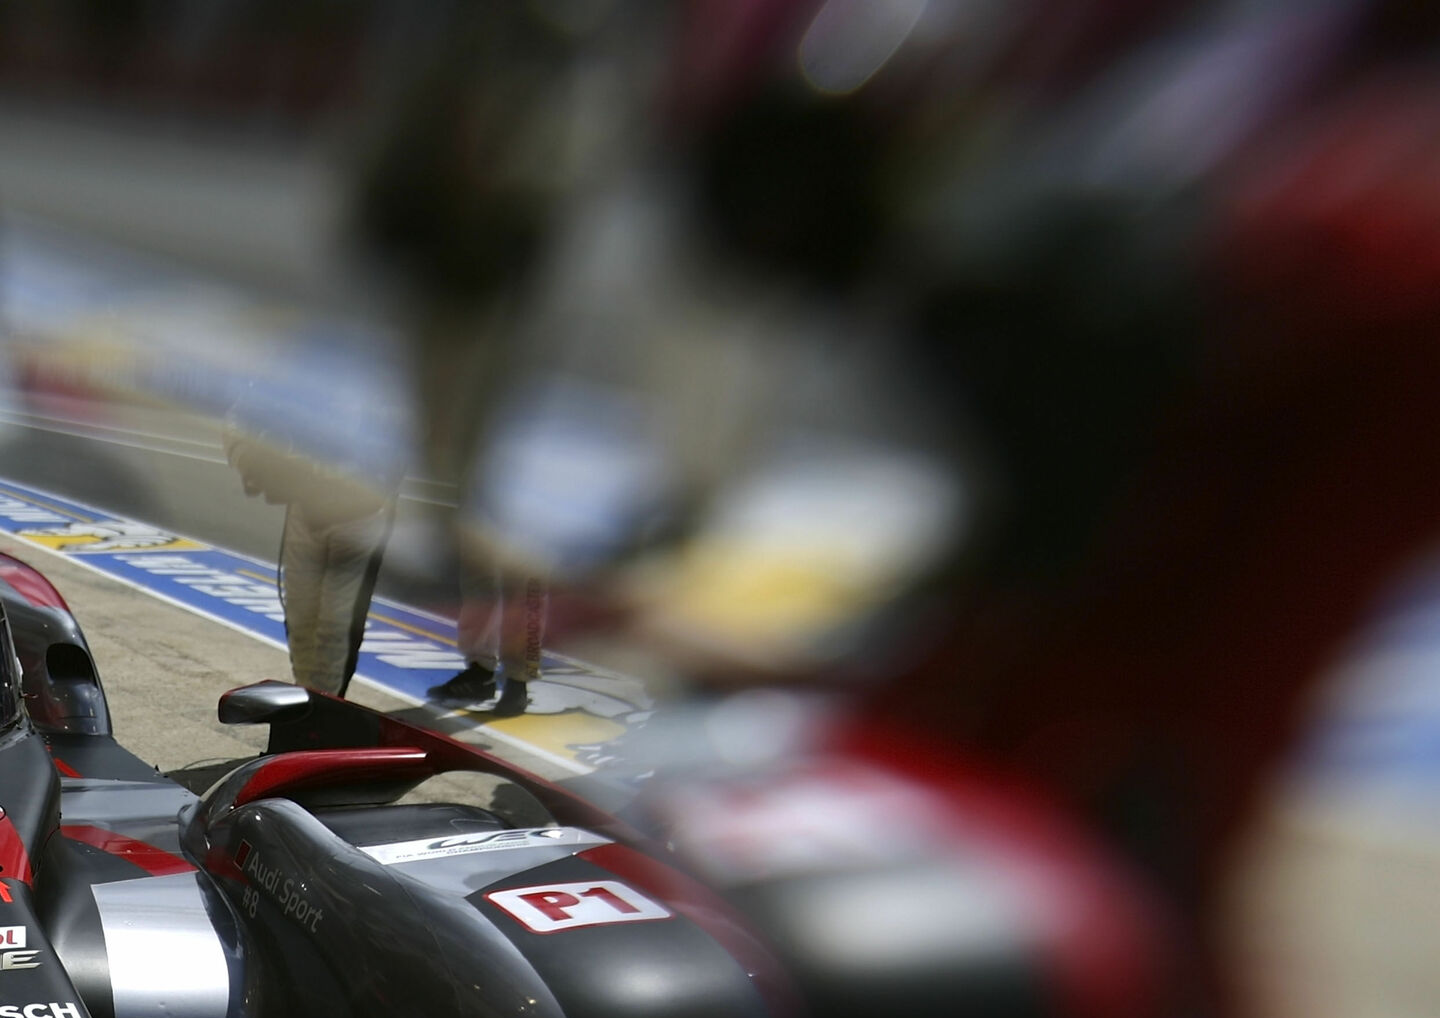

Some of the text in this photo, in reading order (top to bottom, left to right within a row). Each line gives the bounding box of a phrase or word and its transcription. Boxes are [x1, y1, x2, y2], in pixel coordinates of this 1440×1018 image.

[243, 886, 260, 918] #8
[248, 852, 323, 933] Audi Sport
[518, 887, 642, 922] P1
